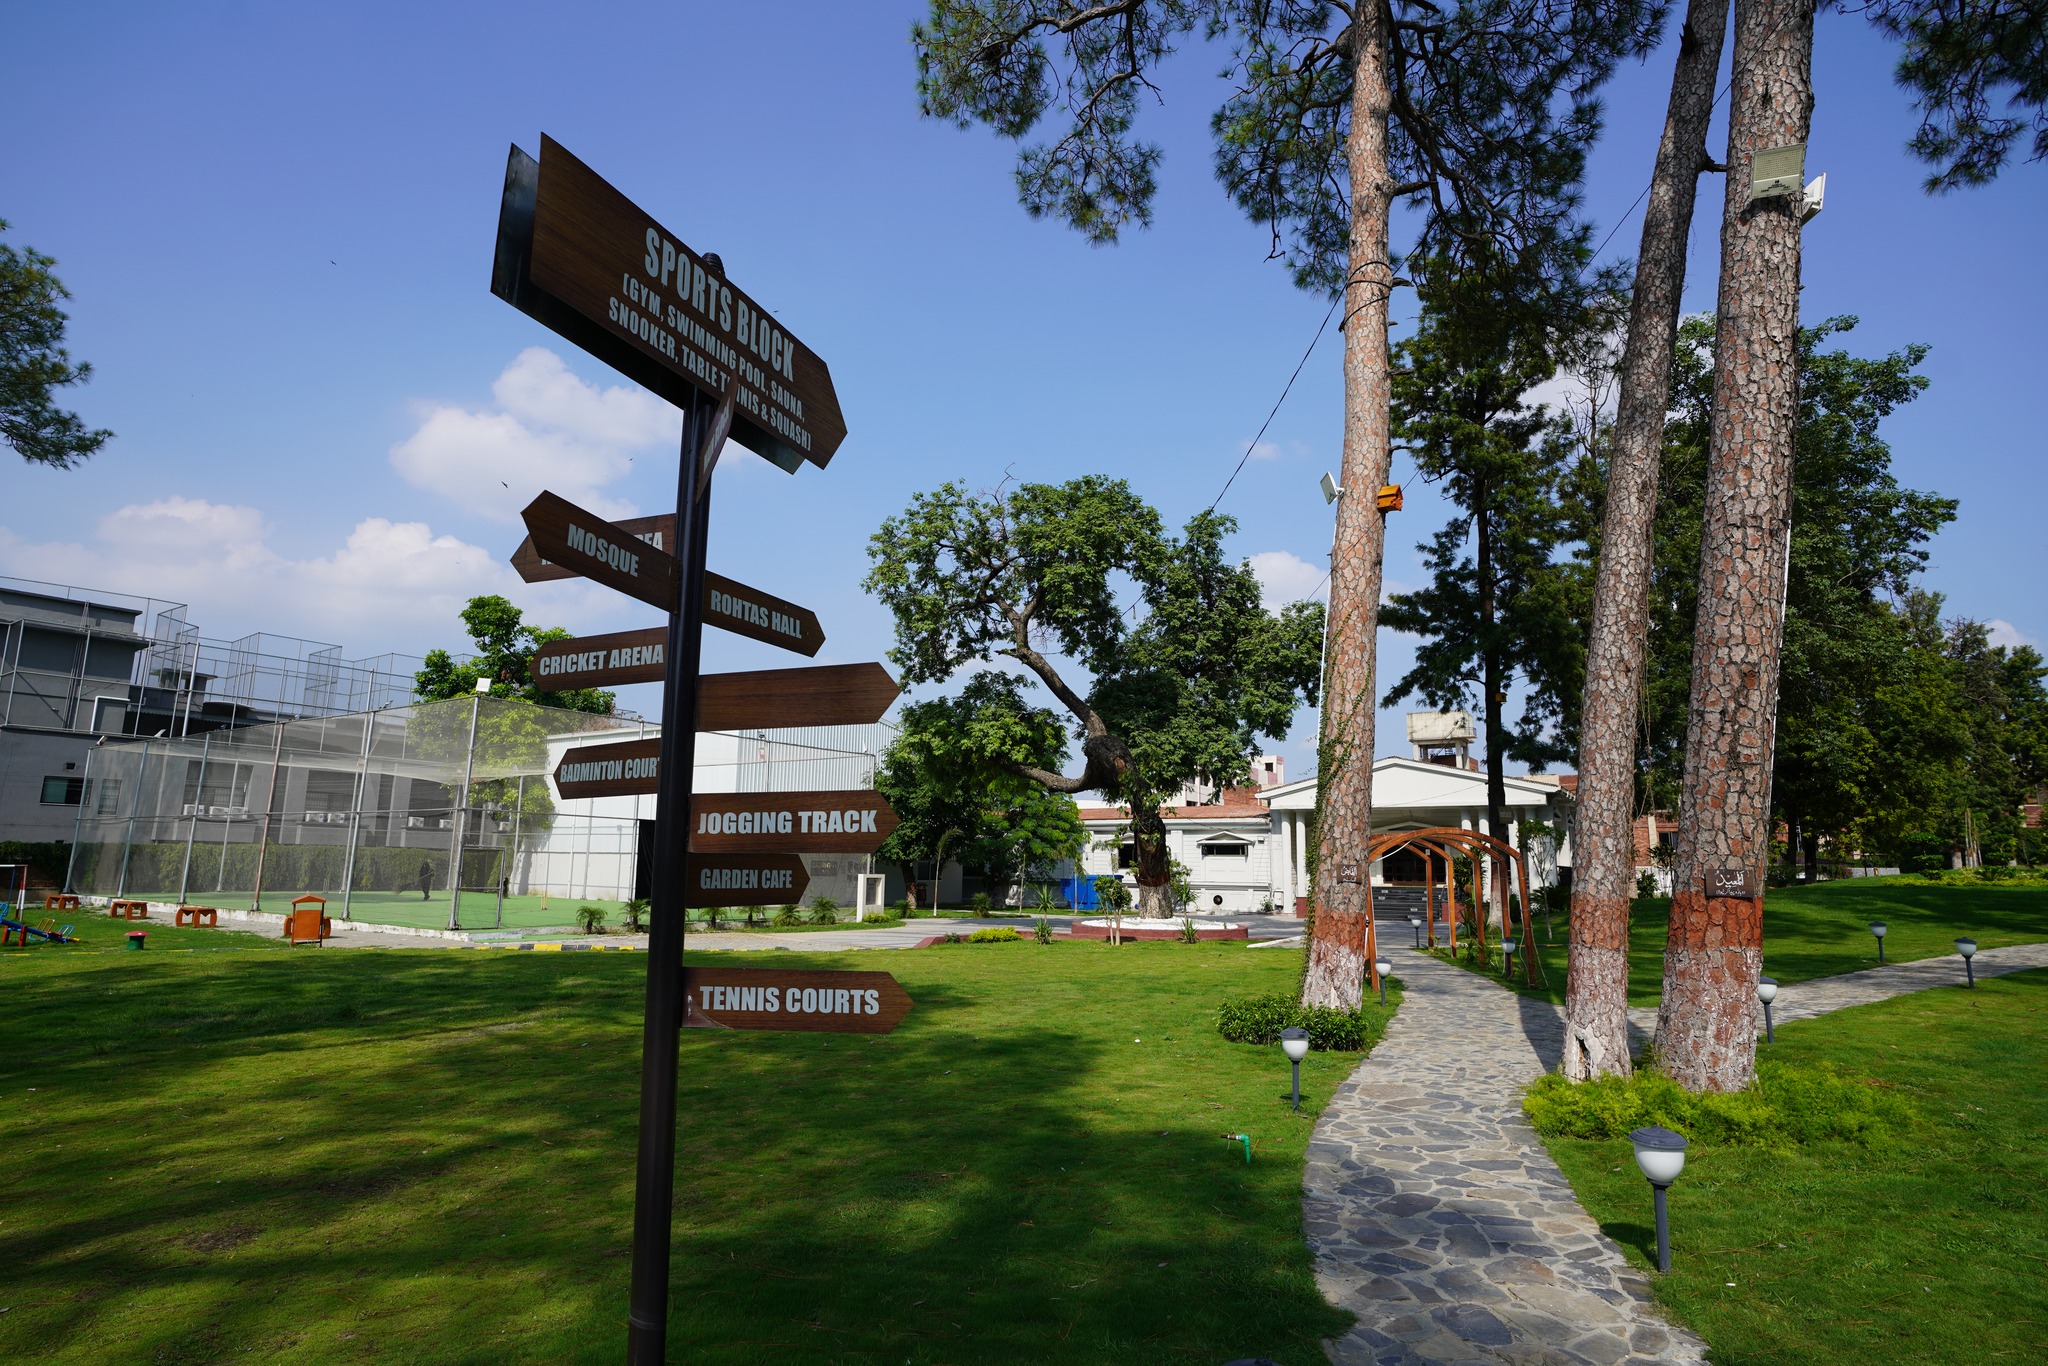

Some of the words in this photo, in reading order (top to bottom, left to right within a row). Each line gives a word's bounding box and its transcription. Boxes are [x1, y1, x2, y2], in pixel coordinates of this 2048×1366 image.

[645, 227, 732, 333] SPORTS
[737, 299, 795, 383] BLOCK
[608, 296, 679, 364] SNOOKER,
[682, 344, 718, 388] TABLE
[760, 405, 769, 422] &
[667, 304, 737, 370] SWIMMING
[738, 357, 769, 397] POOL,
[770, 380, 805, 423] SAUNA,
[567, 523, 640, 578] MOSQUE
[710, 589, 769, 628] ROHTAS
[771, 610, 802, 639] HALL
[539, 651, 607, 676] CRICKET
[608, 644, 664, 669] ARENA
[559, 759, 623, 783] BADMINTON
[624, 757, 660, 780] COUR
[697, 811, 793, 835] JOGGING
[798, 809, 878, 834] TRACK
[700, 868, 758, 890] GARDEN
[761, 869, 793, 889] CAFE
[699, 985, 780, 1013] TENNIS
[785, 987, 880, 1015] COURTS
